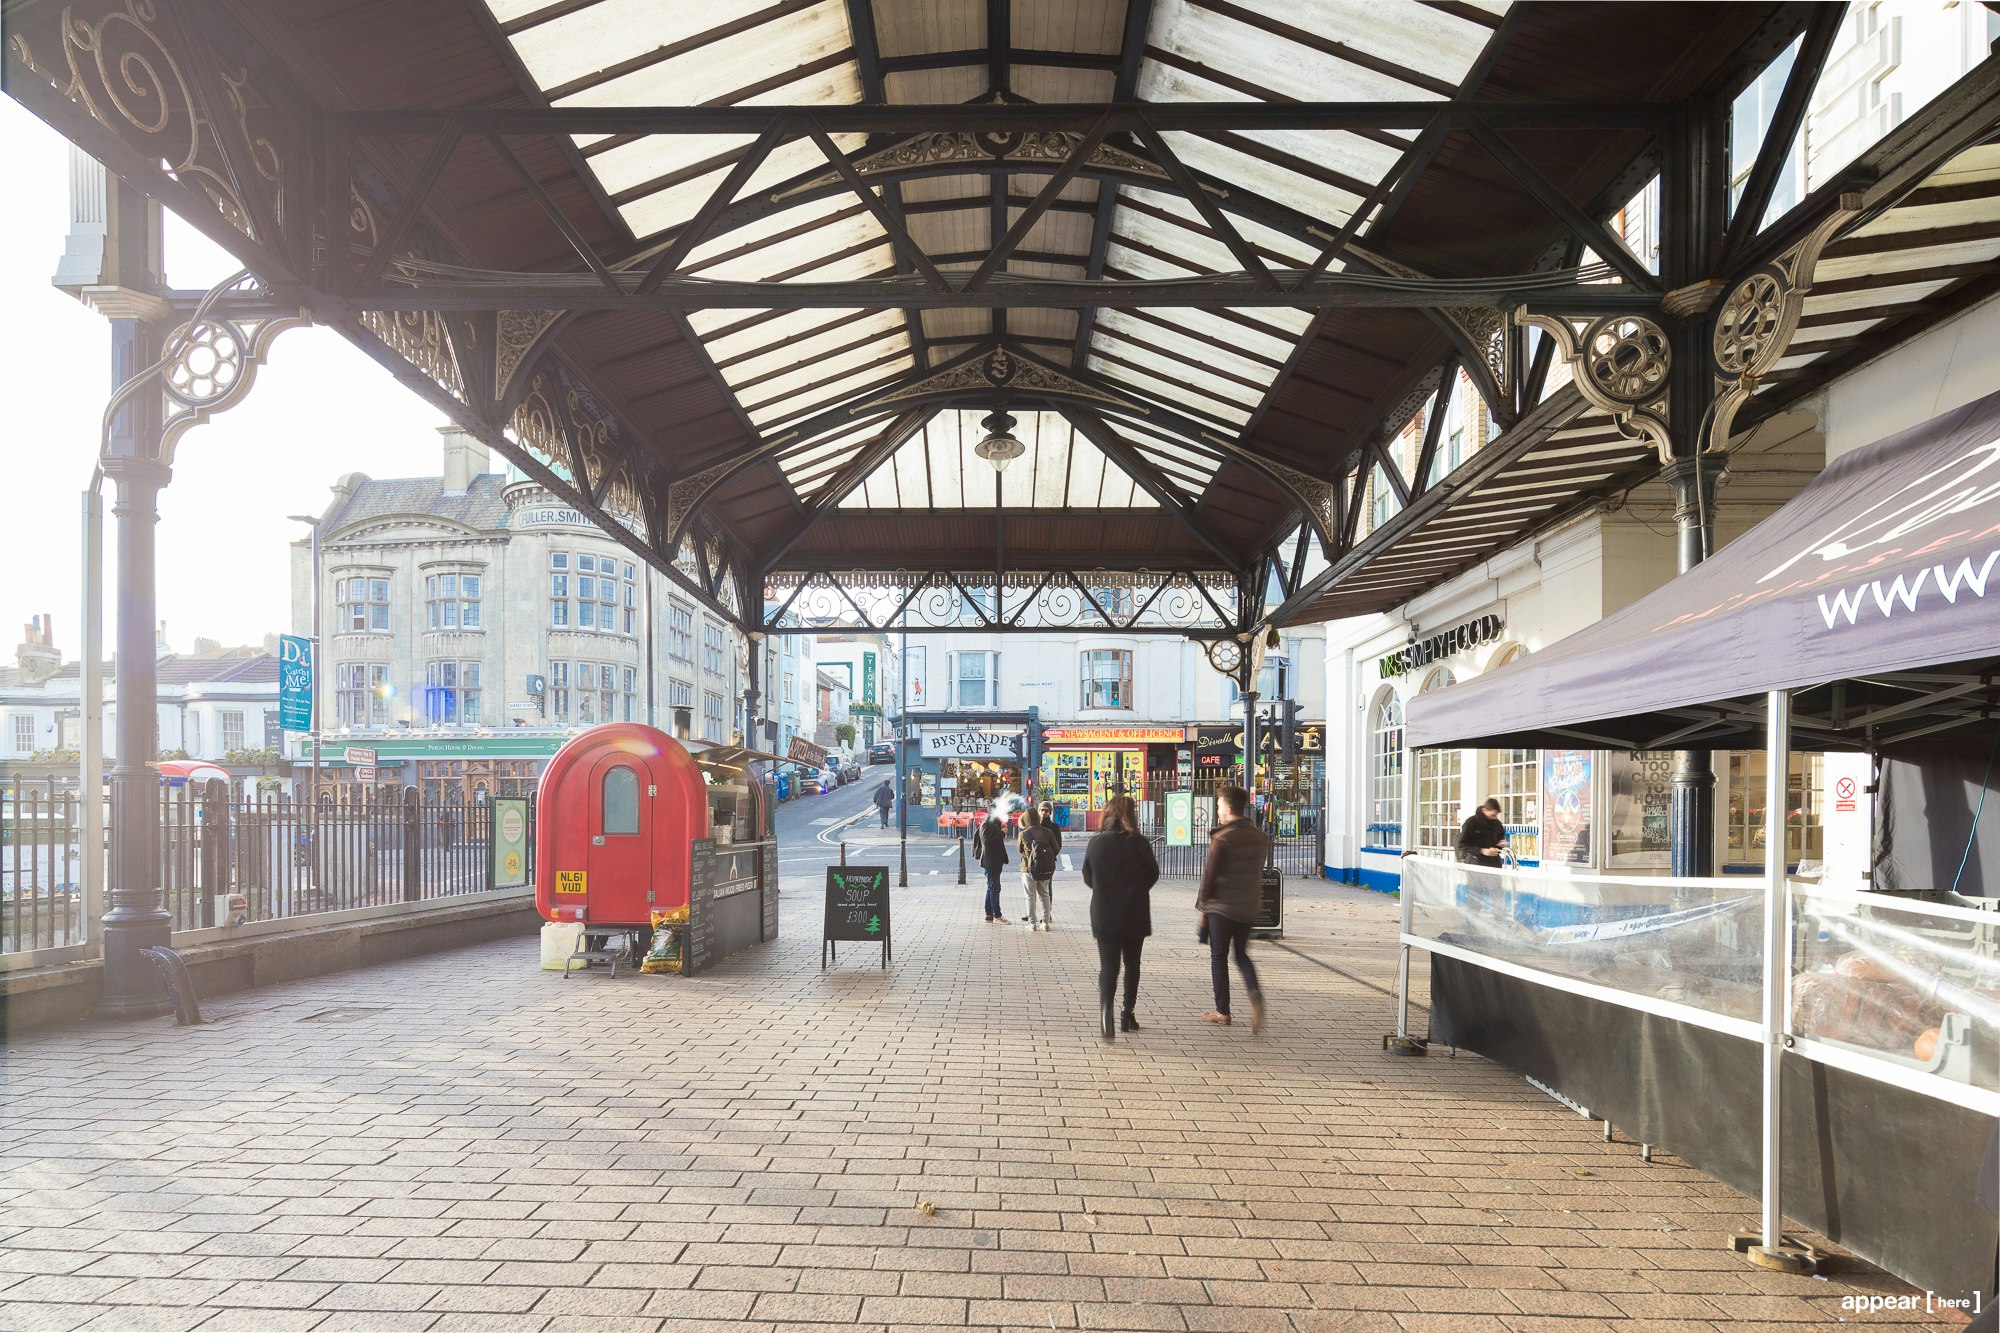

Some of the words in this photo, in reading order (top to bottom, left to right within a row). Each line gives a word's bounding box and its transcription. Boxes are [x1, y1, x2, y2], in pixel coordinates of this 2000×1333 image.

[1756, 439, 2000, 584] Re
[285, 665, 307, 676] Catch
[1379, 651, 1404, 679] M&S
[288, 670, 310, 688] Me!
[1064, 729, 1116, 739] NEWSAGENT
[1118, 729, 1125, 738] &
[1127, 729, 1143, 738] OFF
[1145, 729, 1180, 738] LICENCE
[1197, 732, 1232, 748] Divalls
[1233, 726, 1322, 751] CAÉ
[956, 744, 992, 754] CAFE
[1201, 756, 1220, 764] CAFE
[1640, 761, 1670, 772] TOO
[1645, 783, 1665, 793] TO
[560, 872, 583, 882] NL61
[562, 882, 581, 892] VUD
[845, 889, 870, 902] SOUP
